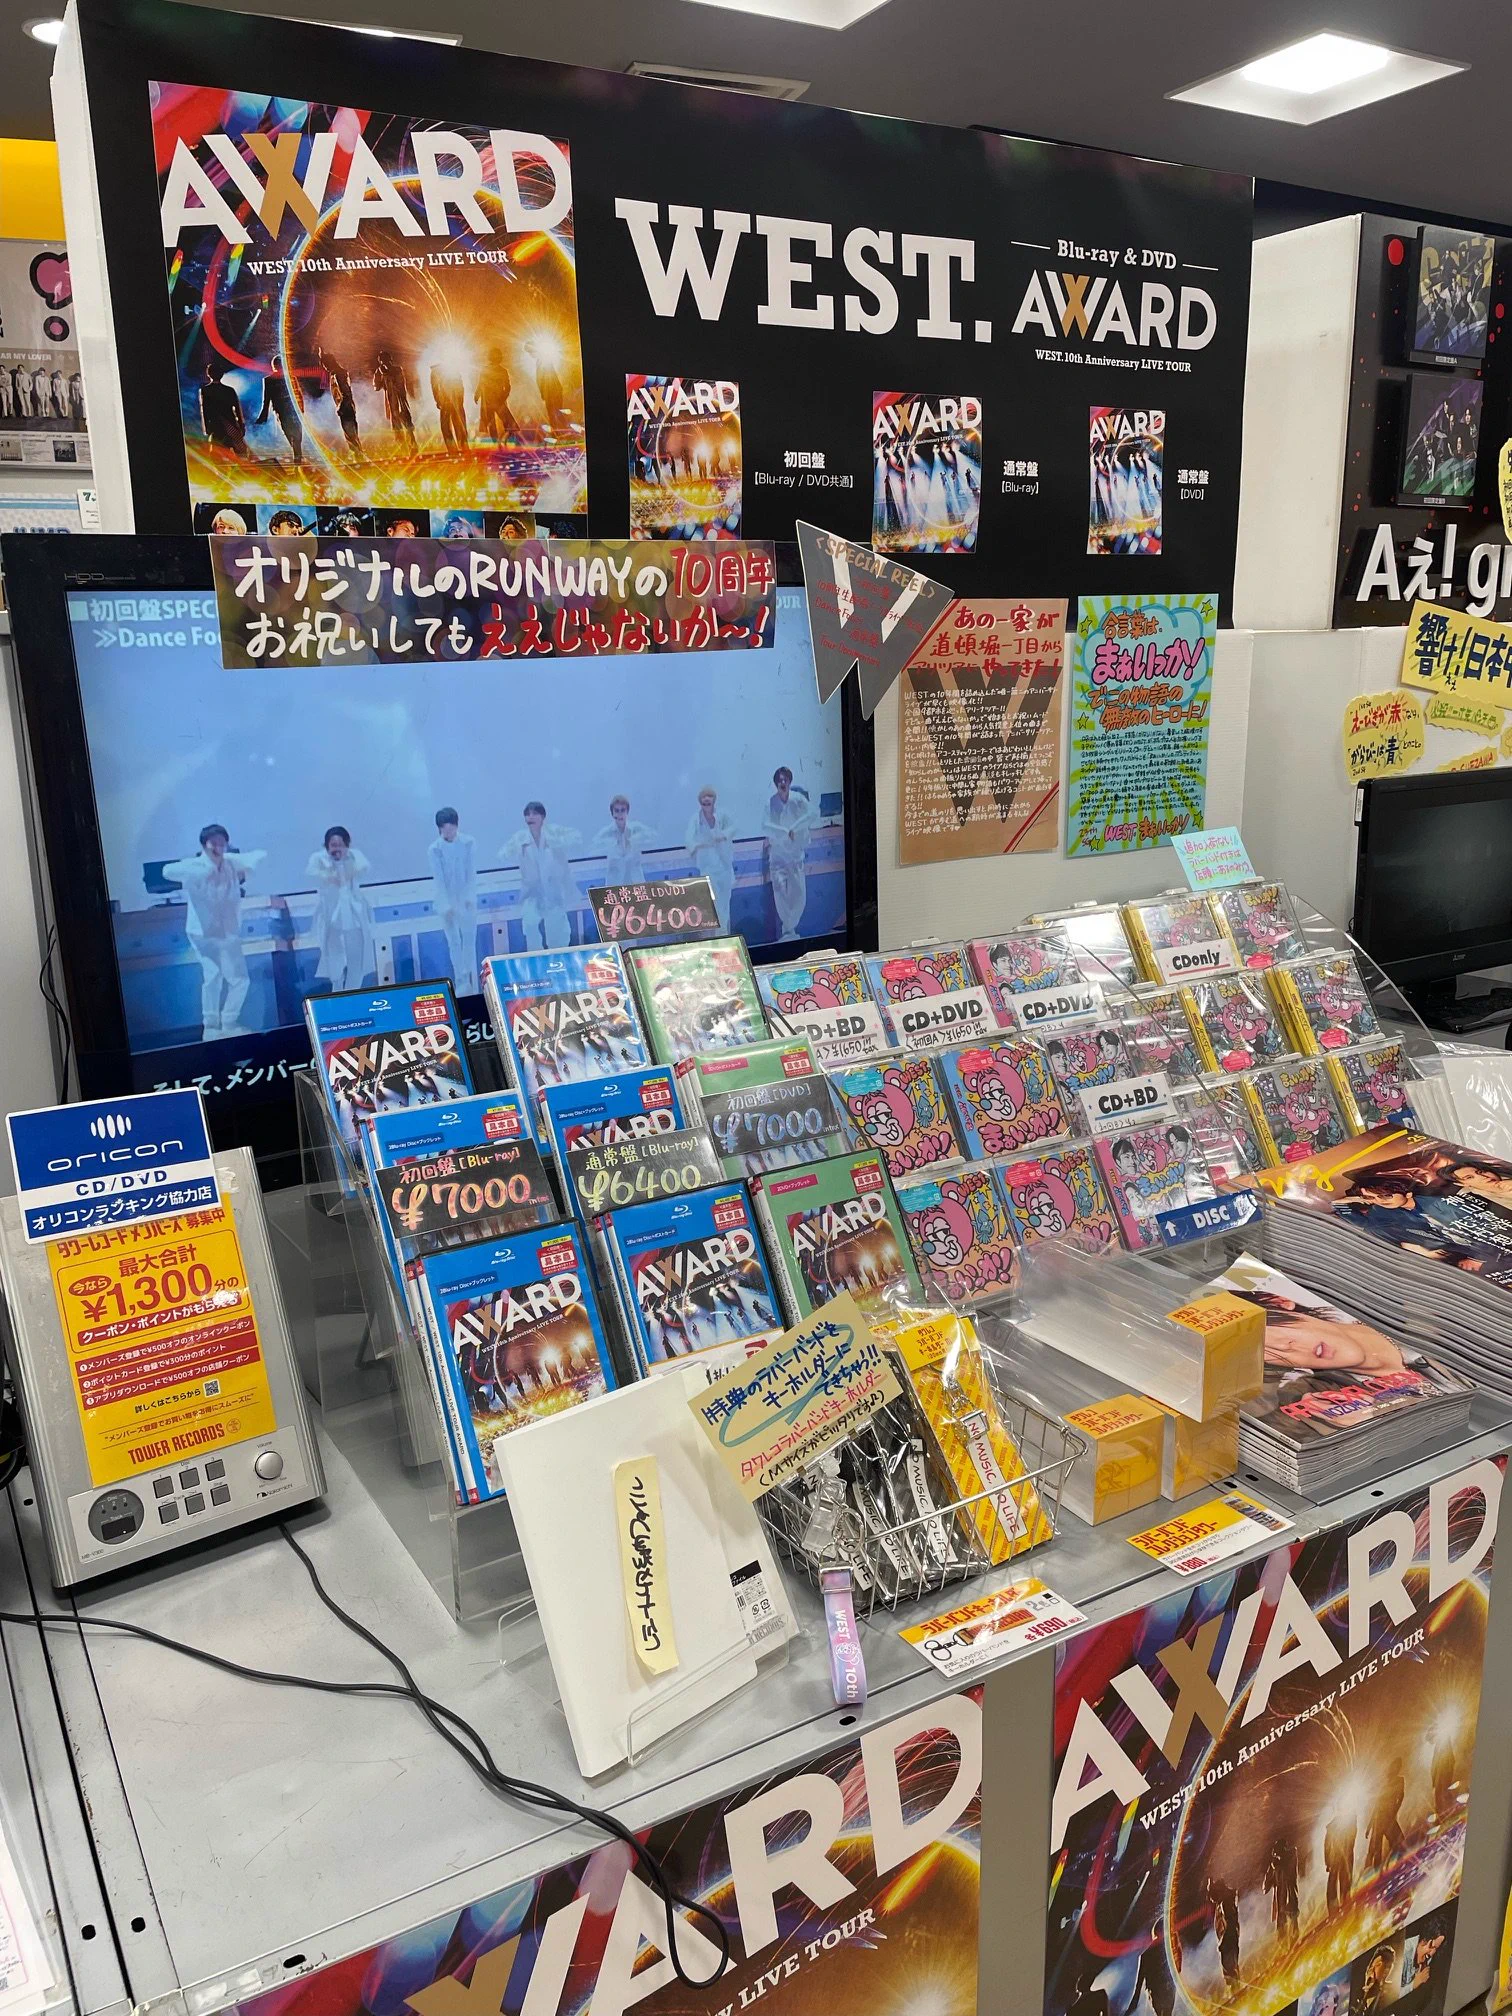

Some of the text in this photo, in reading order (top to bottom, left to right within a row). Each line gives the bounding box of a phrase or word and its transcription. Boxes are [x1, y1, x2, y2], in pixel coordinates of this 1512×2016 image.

[161, 130, 572, 248] AWARD
[300, 257, 332, 273] 10th
[335, 254, 424, 272] Anniversary
[428, 251, 464, 266] LIVE
[465, 250, 509, 265] TOUR
[615, 198, 992, 344] WEST.
[1057, 240, 1177, 270] Blu-ray & DVD
[1011, 269, 1218, 351] AWARD
[1085, 354, 1192, 372] Anniversary LIVE TOUR
[627, 381, 740, 421] AWARD
[873, 397, 982, 440] AWARD
[1090, 410, 1166, 443] AWARD
[783, 450, 826, 469] 初回盤
[1003, 461, 1039, 479] 通常盤
[119, 627, 187, 649] Dance
[599, 903, 702, 938] ¥6400
[513, 987, 626, 1044] AWARD
[902, 1000, 984, 1033] CD+DVD
[328, 1024, 456, 1085] AWARD
[1099, 1085, 1159, 1114] CD+BD
[712, 1107, 823, 1154] ¥7000
[47, 1140, 184, 1172] oricon
[76, 1170, 168, 1197] CD/DVD
[392, 1173, 530, 1230] ¥7000
[578, 1164, 702, 1212] ¥6400
[32, 1185, 213, 1232] オリコンランキング協力店
[793, 1192, 887, 1259] AWARD
[1193, 1204, 1231, 1230] DISC
[118, 1242, 197, 1278] 最大合計
[638, 1228, 755, 1307] AWARD
[71, 1277, 109, 1295] 今なら
[454, 1272, 582, 1355] AWARD
[134, 1388, 201, 1415] 詳しくはこちらから
[128, 1421, 225, 1465] TOWER RECORDS
[1050, 1459, 1504, 1854] AWARD
[843, 1667, 858, 1699] 10th
[1198, 1759, 1234, 1793] 10th
[1237, 1690, 1337, 1766] Anniversary
[1339, 1658, 1379, 1698] LIVE
[1381, 1627, 1425, 1668] TOUR
[738, 1908, 876, 2009] LIVE TOUR
